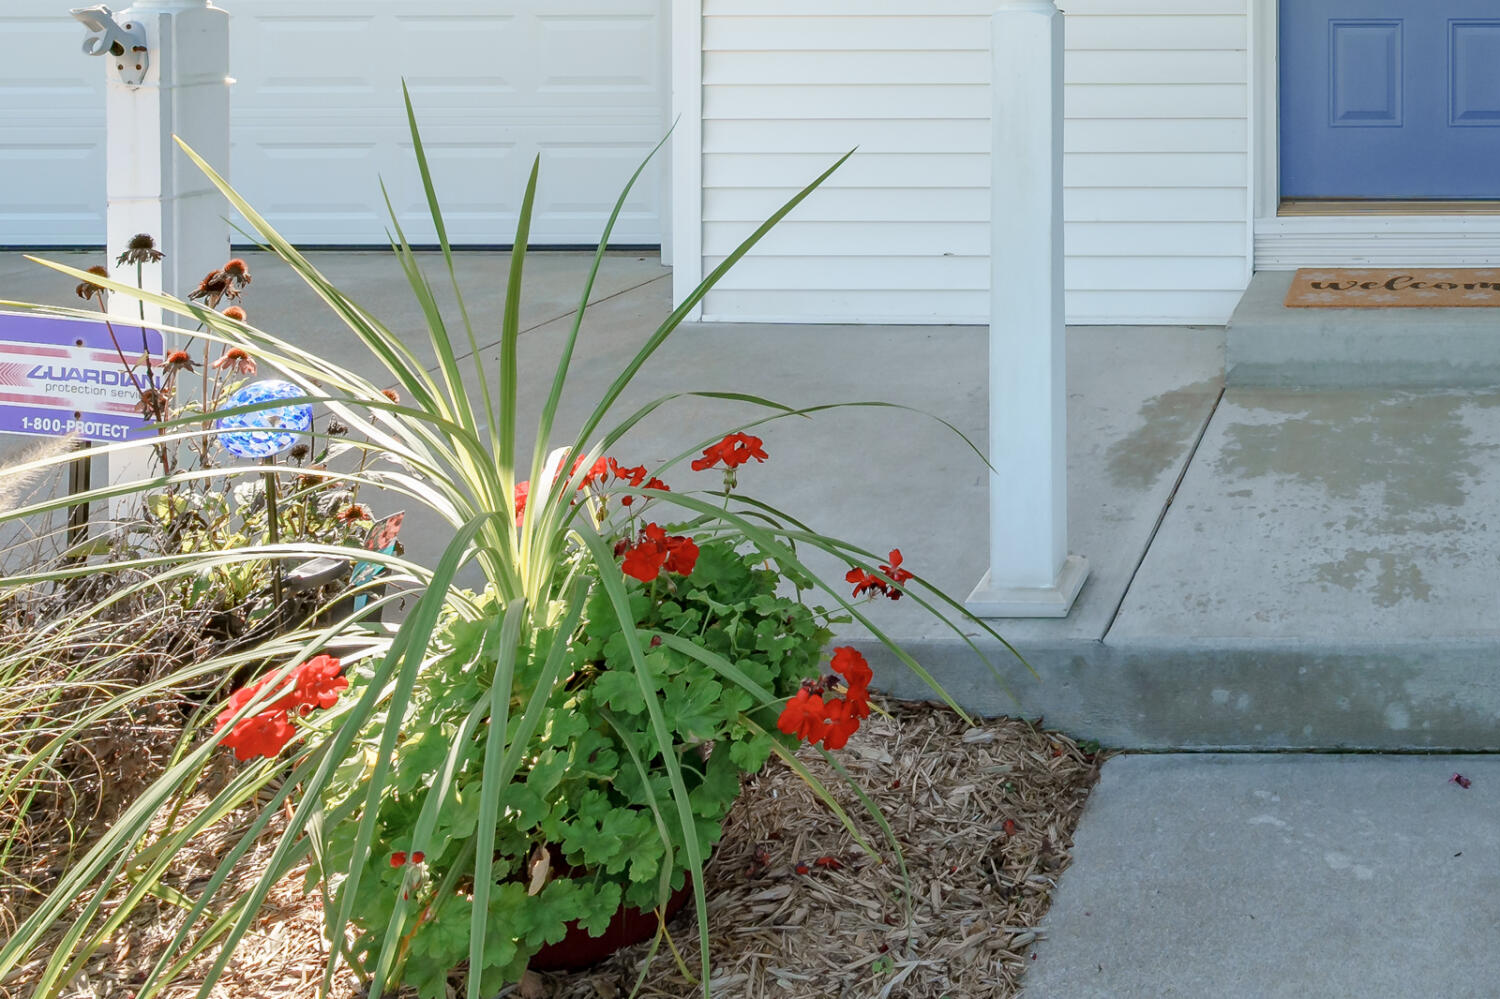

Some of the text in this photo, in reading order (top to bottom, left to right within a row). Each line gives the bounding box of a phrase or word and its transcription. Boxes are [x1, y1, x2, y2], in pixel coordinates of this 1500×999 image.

[27, 364, 161, 390] GUARDIAN
[45, 382, 107, 396] protection
[21, 416, 130, 439] 1-800-PROTECT
